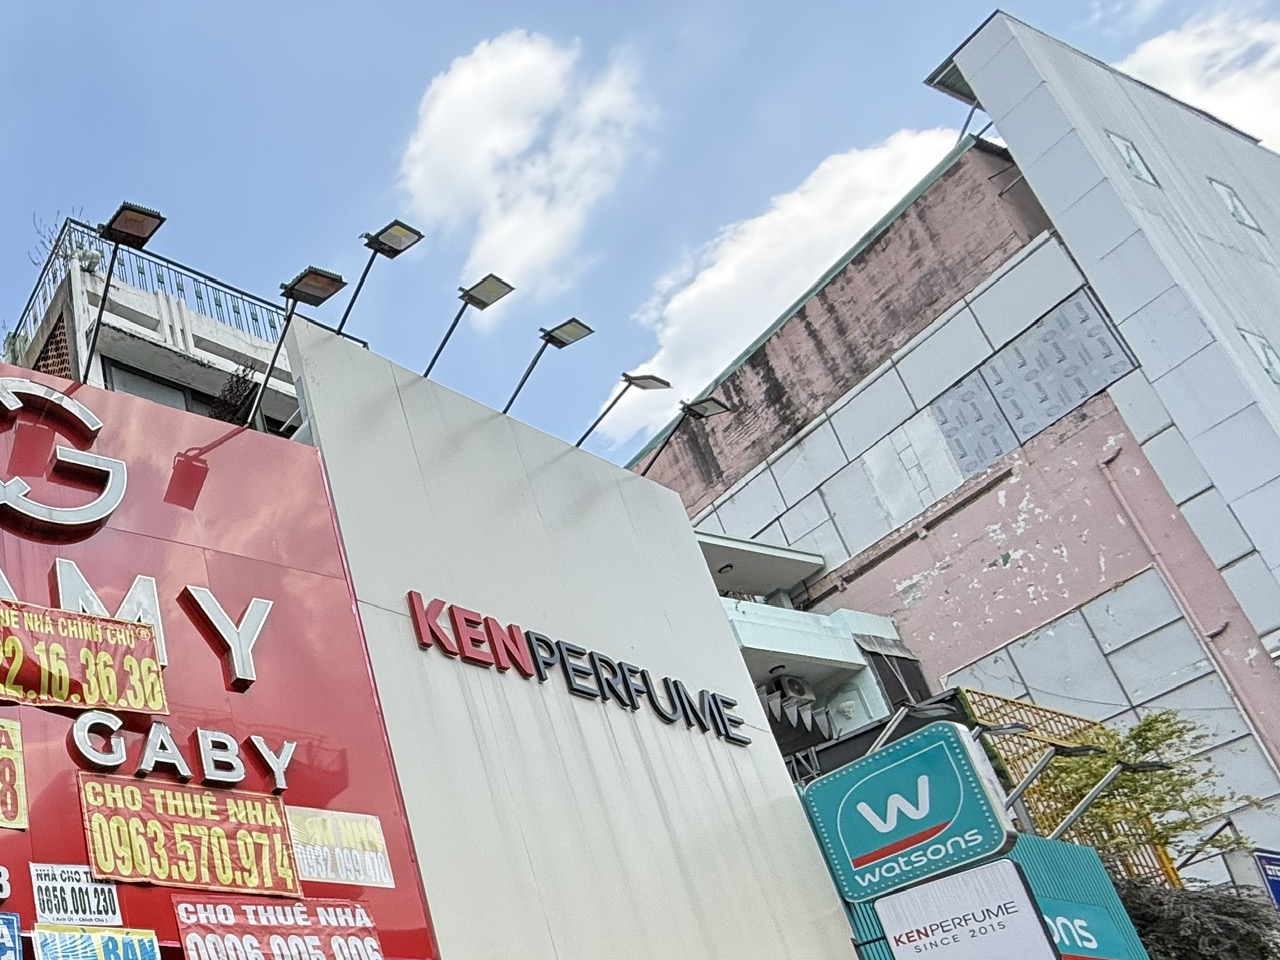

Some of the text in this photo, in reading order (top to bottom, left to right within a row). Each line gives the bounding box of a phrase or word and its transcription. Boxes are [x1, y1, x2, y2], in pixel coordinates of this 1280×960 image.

[24, 612, 54, 635] NHÀ
[58, 619, 102, 641] CHÍNH
[407, 590, 752, 747] KENPERFUME
[73, 710, 296, 794] GABY
[85, 781, 282, 827] CHO THUÊ NHÀ
[91, 813, 294, 889] 0963.570.974
[855, 829, 983, 886] watsons
[61, 870, 81, 882] CHO
[37, 885, 116, 915] 0856.001.230
[178, 903, 373, 927] CHO THUÊ NHÀ
[893, 901, 1019, 947] KENPERFUME
[914, 921, 1006, 953] SINCE 2015
